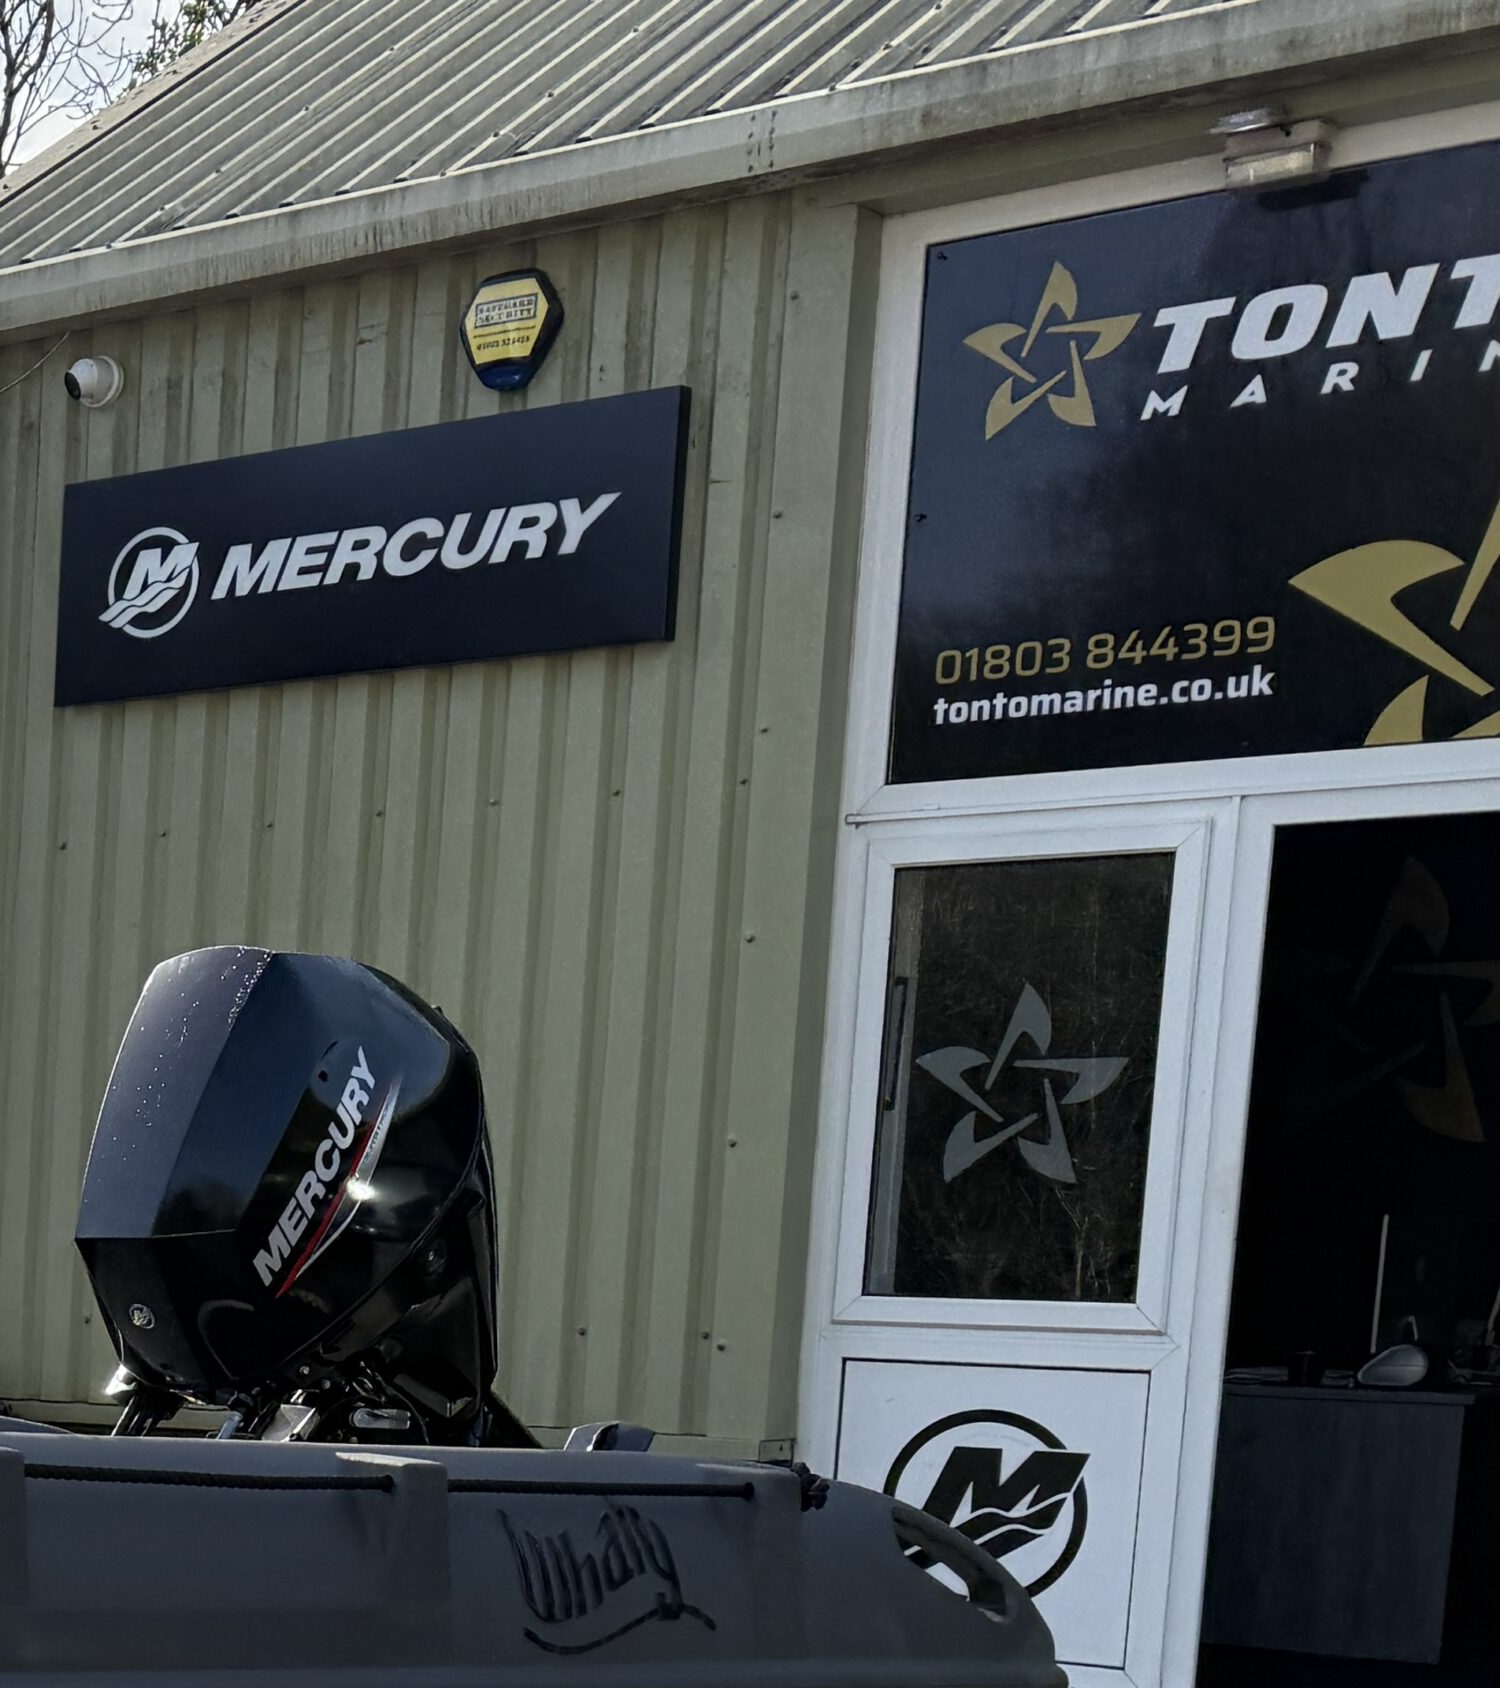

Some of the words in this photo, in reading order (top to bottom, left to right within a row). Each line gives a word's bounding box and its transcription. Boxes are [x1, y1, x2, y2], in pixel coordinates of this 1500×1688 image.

[211, 492, 622, 600] MERCURY
[935, 638, 1072, 686] 01803
[1086, 615, 1276, 671] 844399
[933, 665, 1274, 726] tontomarine.co.uk
[252, 1045, 377, 1287] MERCURY
